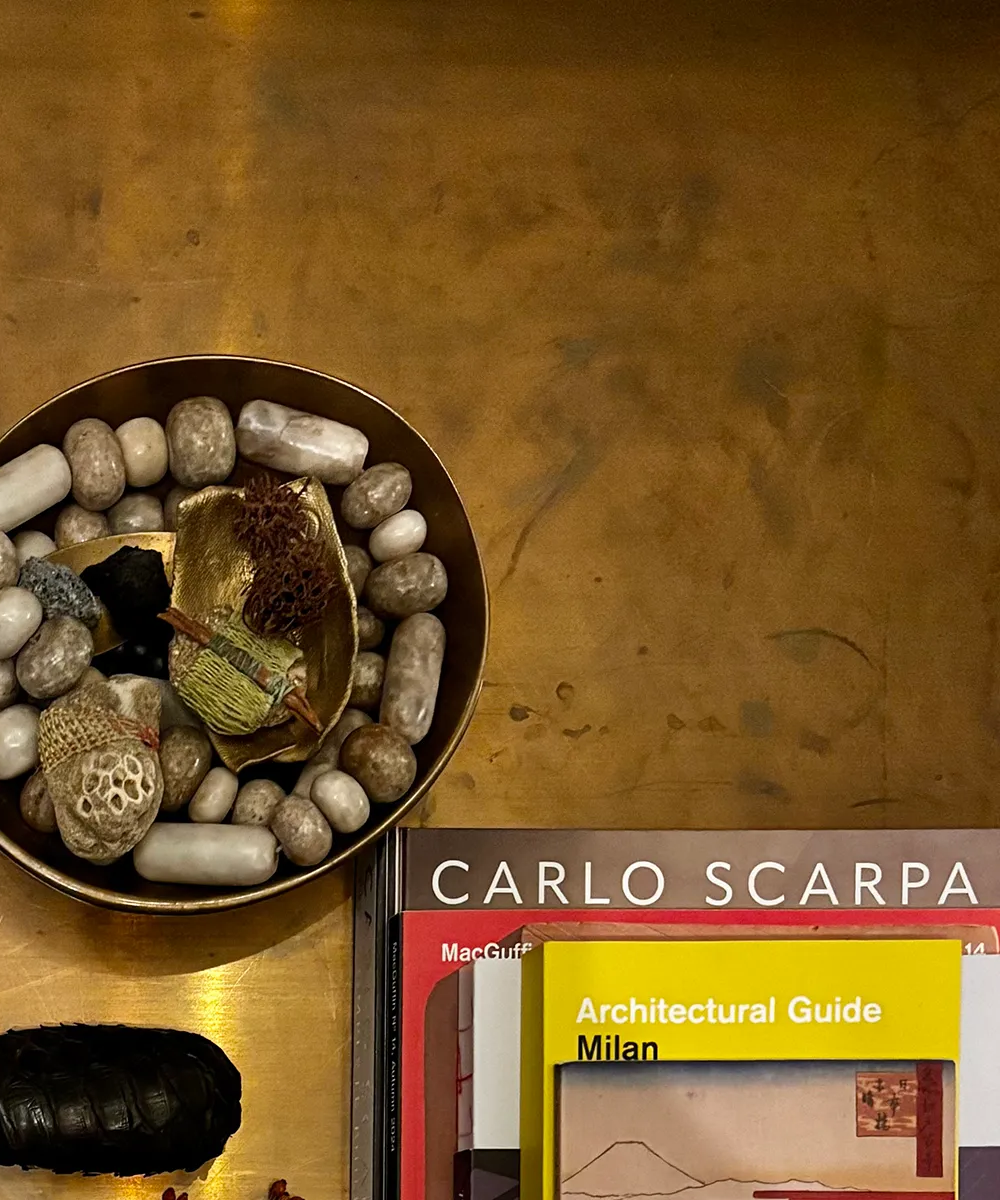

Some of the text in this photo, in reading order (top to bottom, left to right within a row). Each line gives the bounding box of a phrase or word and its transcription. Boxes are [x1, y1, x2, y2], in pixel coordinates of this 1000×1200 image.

[431, 860, 979, 906] CARLO SCARPA
[576, 996, 882, 1024] Architectural Guide
[577, 1034, 659, 1060] Milan
